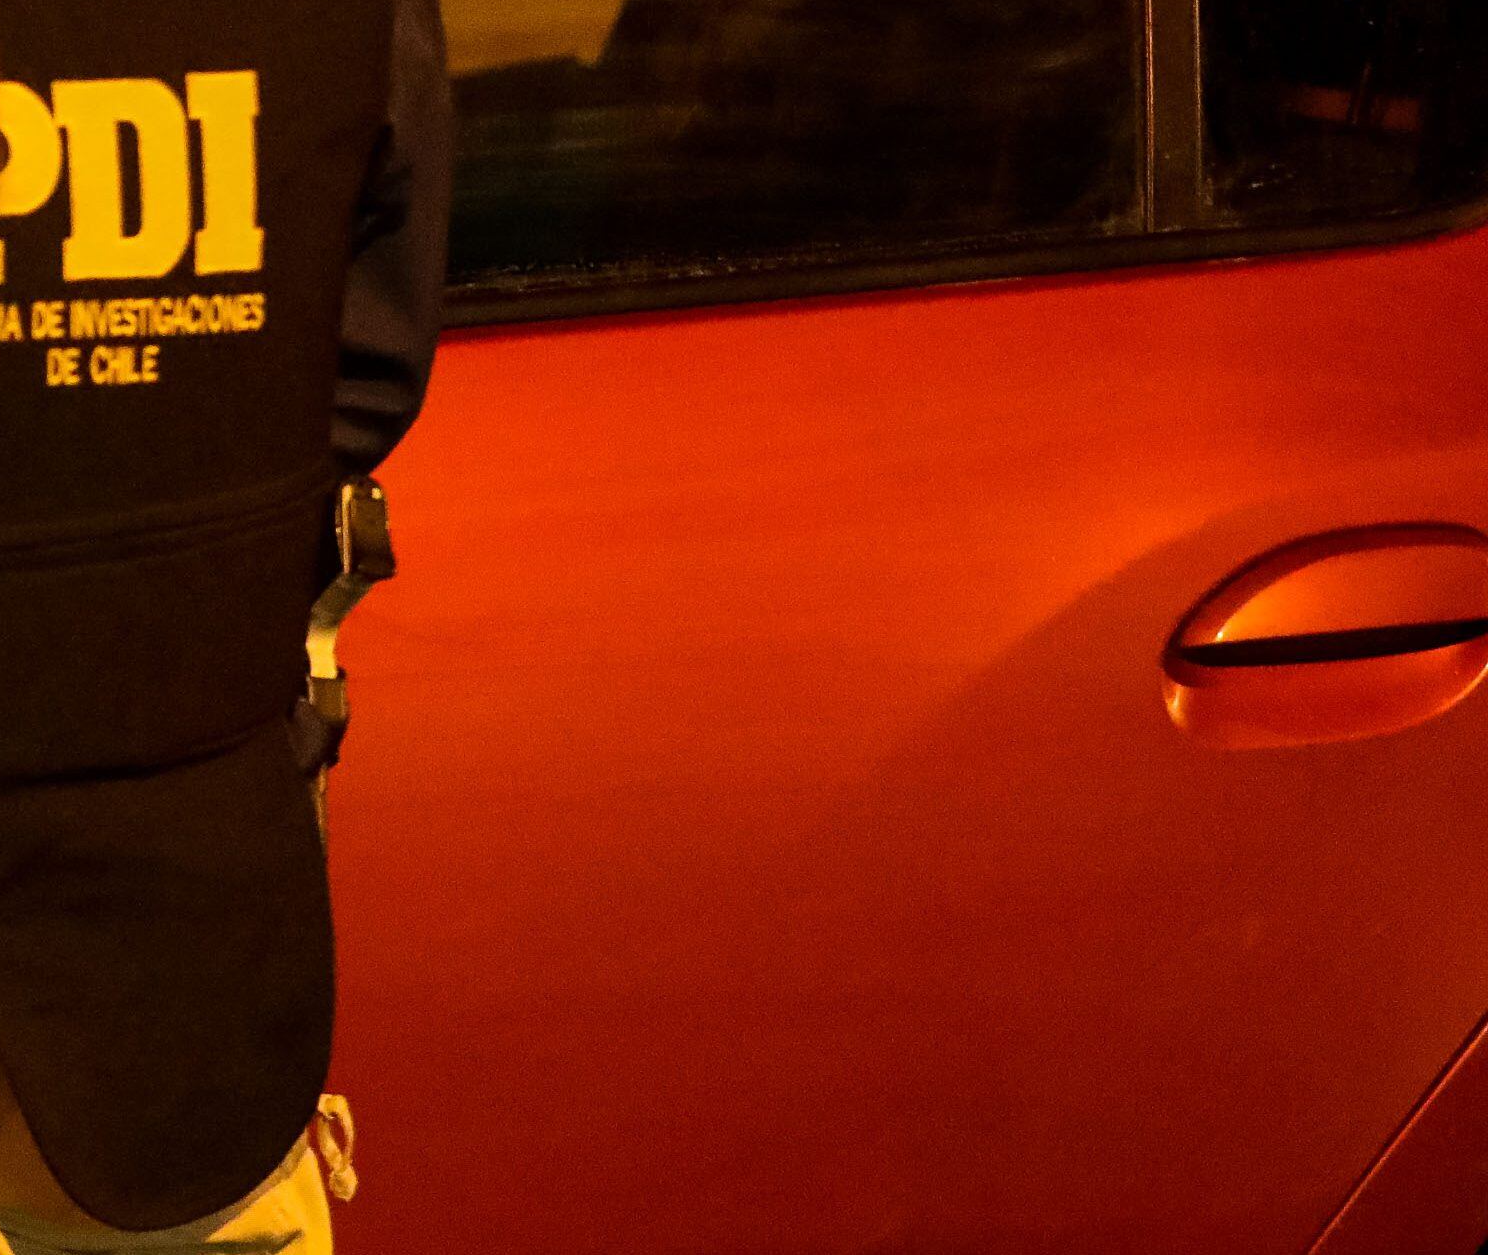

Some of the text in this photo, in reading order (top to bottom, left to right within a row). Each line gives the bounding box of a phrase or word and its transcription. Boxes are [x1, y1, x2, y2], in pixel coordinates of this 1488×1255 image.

[31, 300, 66, 340] DE
[70, 293, 265, 339] INVESTIGACIONES
[46, 344, 161, 386] DE CHILE
